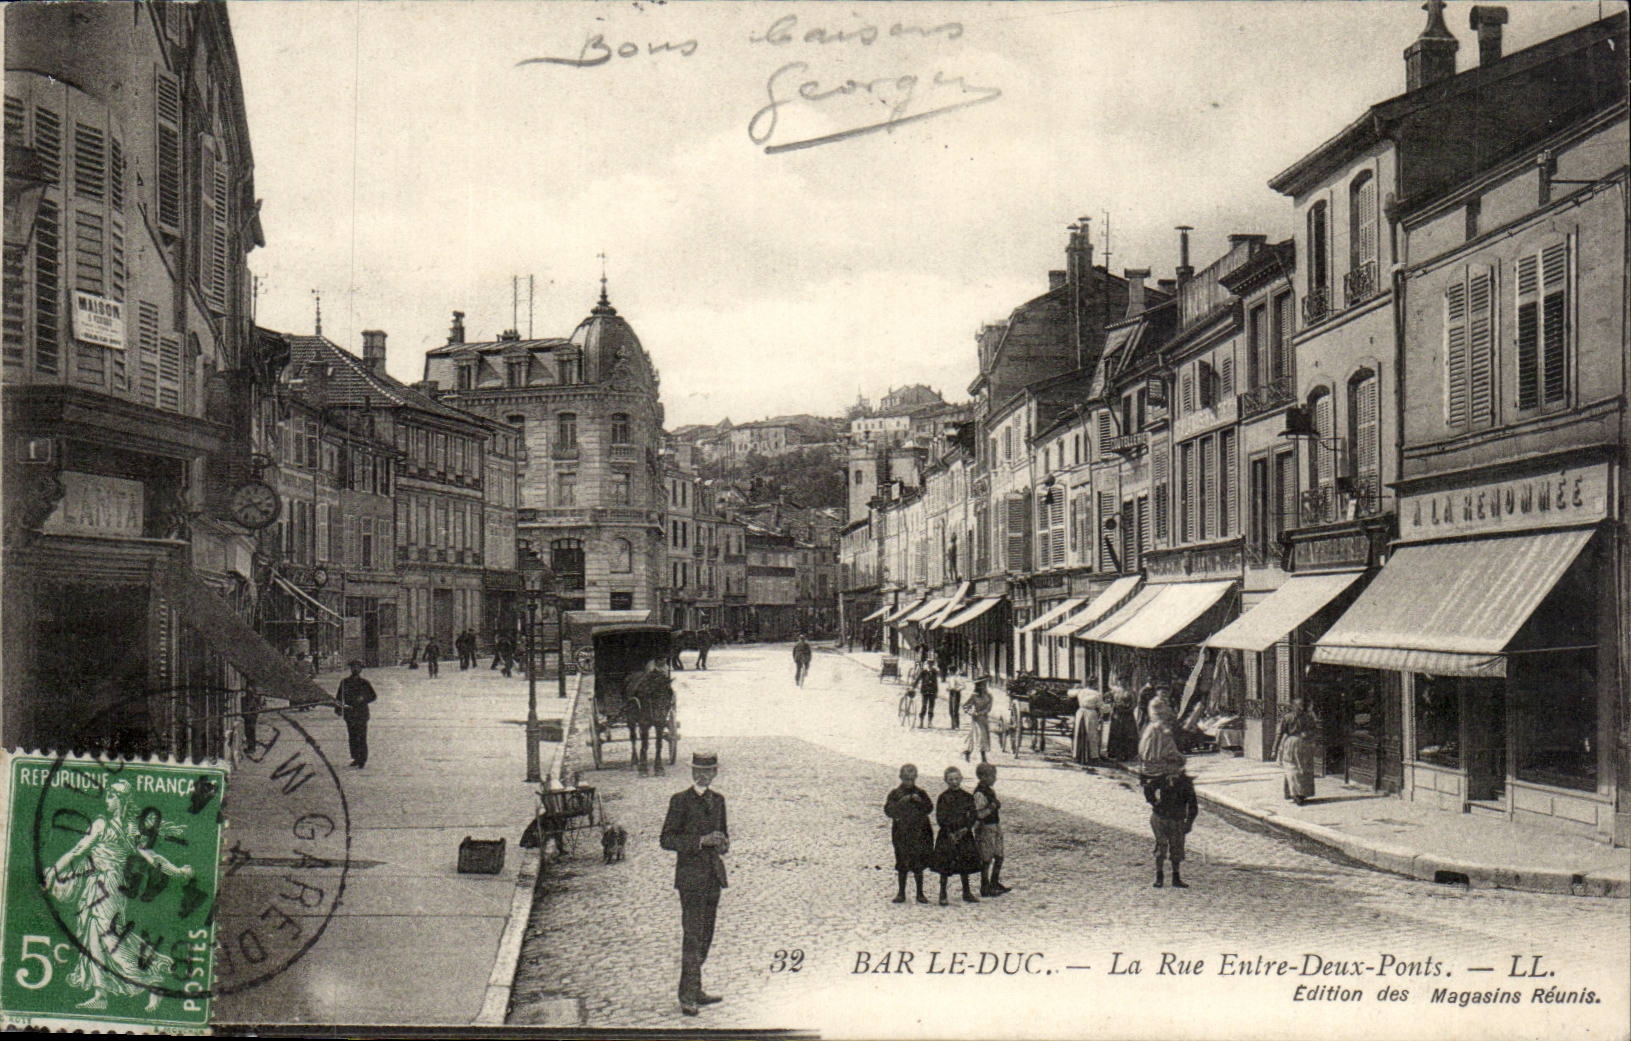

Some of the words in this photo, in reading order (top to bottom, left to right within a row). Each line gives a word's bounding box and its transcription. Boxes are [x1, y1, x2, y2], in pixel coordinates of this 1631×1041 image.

[1413, 500, 1422, 527] A
[1431, 497, 1454, 526] LA
[1463, 468, 1584, 522] RENOMMÉE
[183, 928, 209, 1012] POSTES
